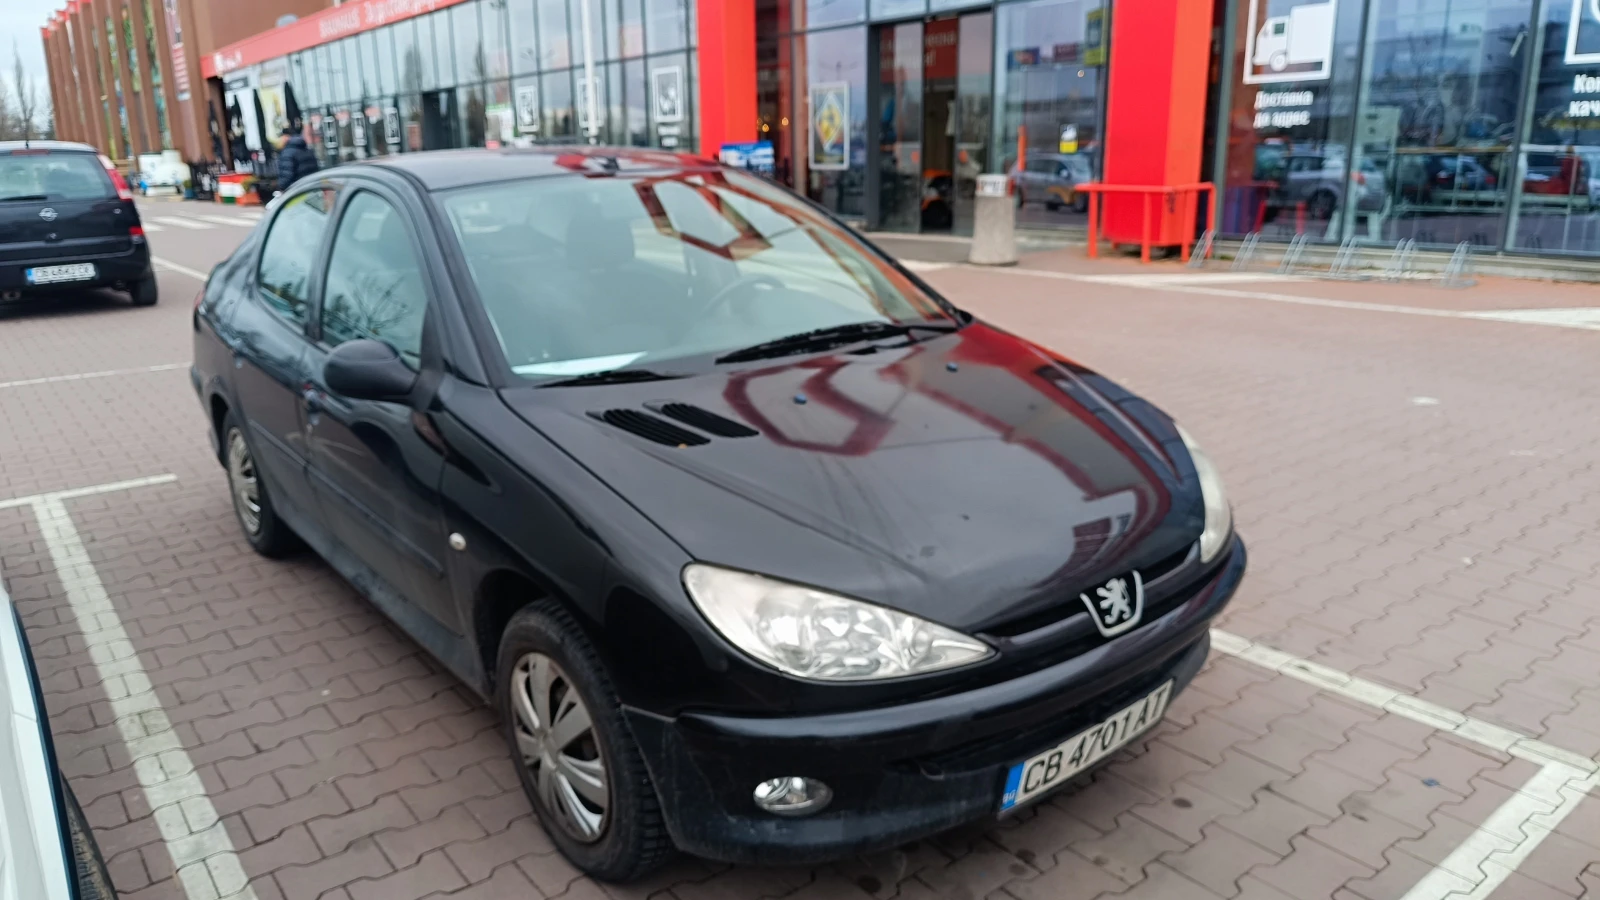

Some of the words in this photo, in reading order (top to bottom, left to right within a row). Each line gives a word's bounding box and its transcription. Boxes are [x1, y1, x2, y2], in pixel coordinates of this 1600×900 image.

[1254, 91, 1314, 110] Доставка
[1253, 111, 1271, 129] до
[1271, 110, 1311, 128] адрес
[1067, 710, 1131, 768] 4701
